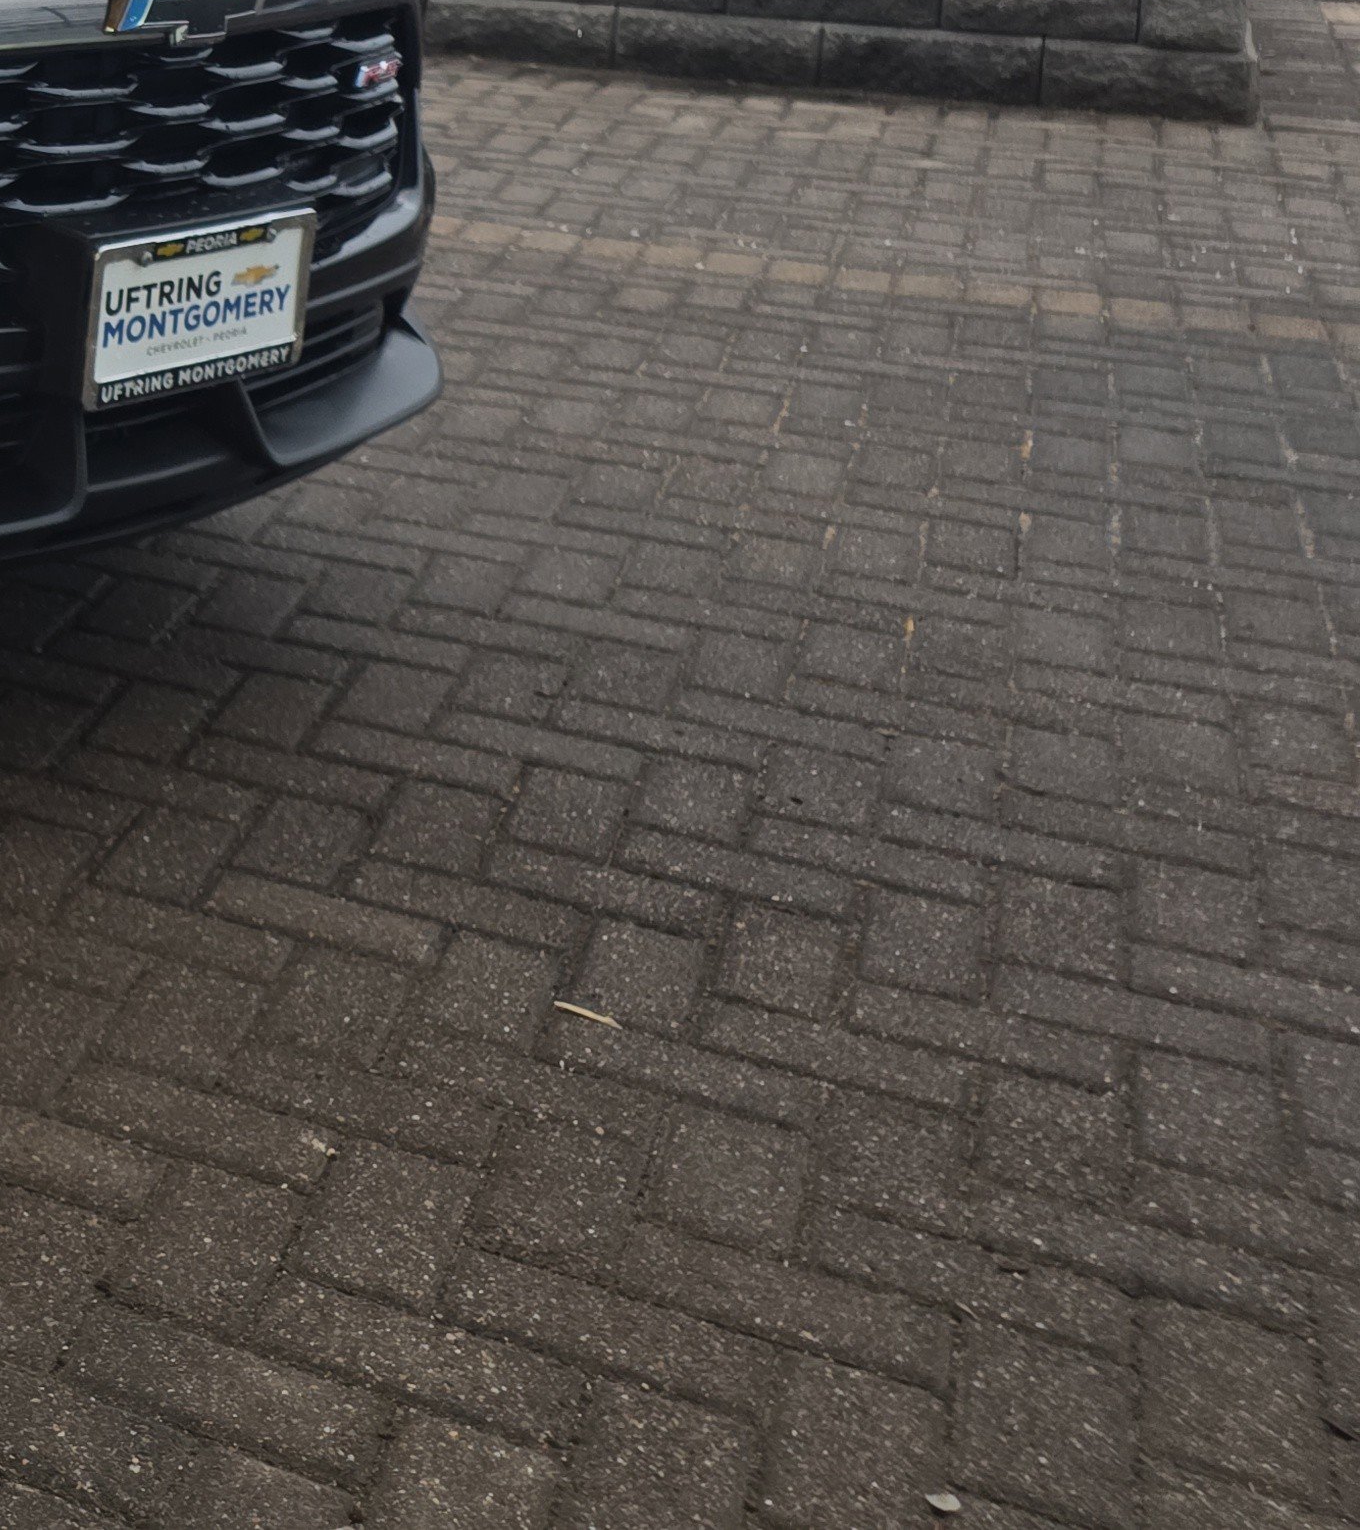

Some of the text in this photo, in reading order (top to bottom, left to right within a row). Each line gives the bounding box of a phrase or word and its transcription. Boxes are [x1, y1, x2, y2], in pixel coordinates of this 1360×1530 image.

[102, 284, 291, 349] MONTGOMERY
[105, 270, 222, 316] UFTRING
[101, 345, 291, 404] UFTRING MONTGOMERY
